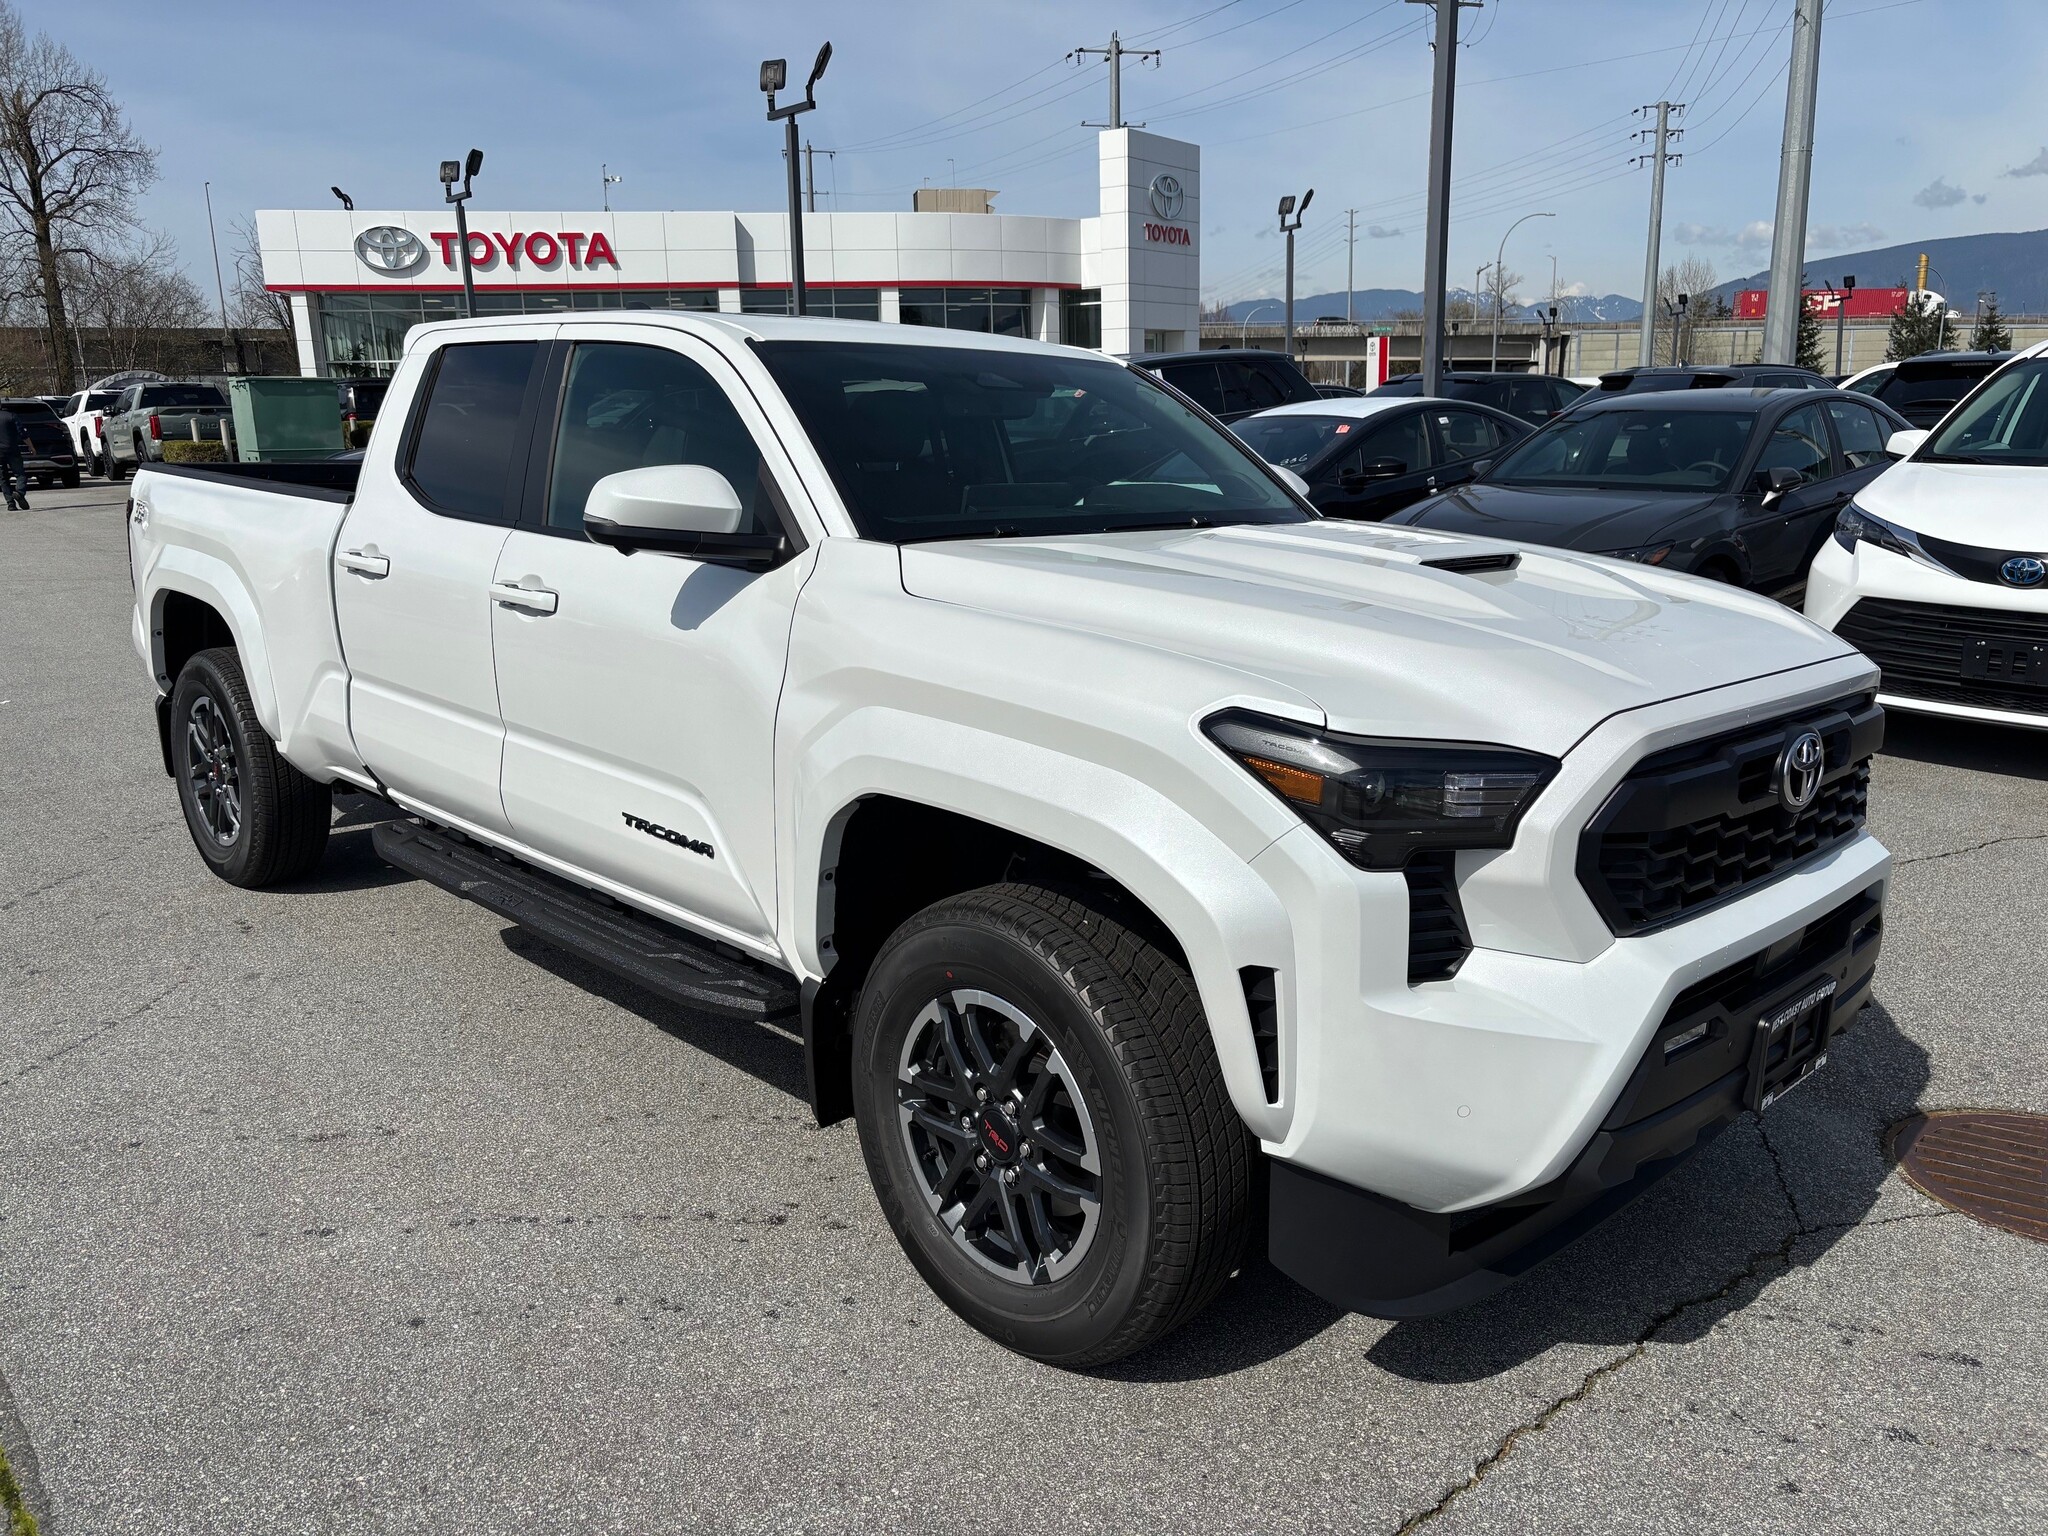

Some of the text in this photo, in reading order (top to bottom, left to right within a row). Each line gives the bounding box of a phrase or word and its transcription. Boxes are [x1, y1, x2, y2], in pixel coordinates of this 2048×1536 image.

[430, 231, 617, 266] TOYOTA
[1144, 222, 1191, 246] TOYOTA
[1321, 325, 1360, 333] MEADOWS
[622, 811, 715, 860] TACOMA
[1800, 992, 1817, 1012] AUTO
[1816, 981, 1837, 1002] GROUP
[984, 1119, 1009, 1153] TRD
